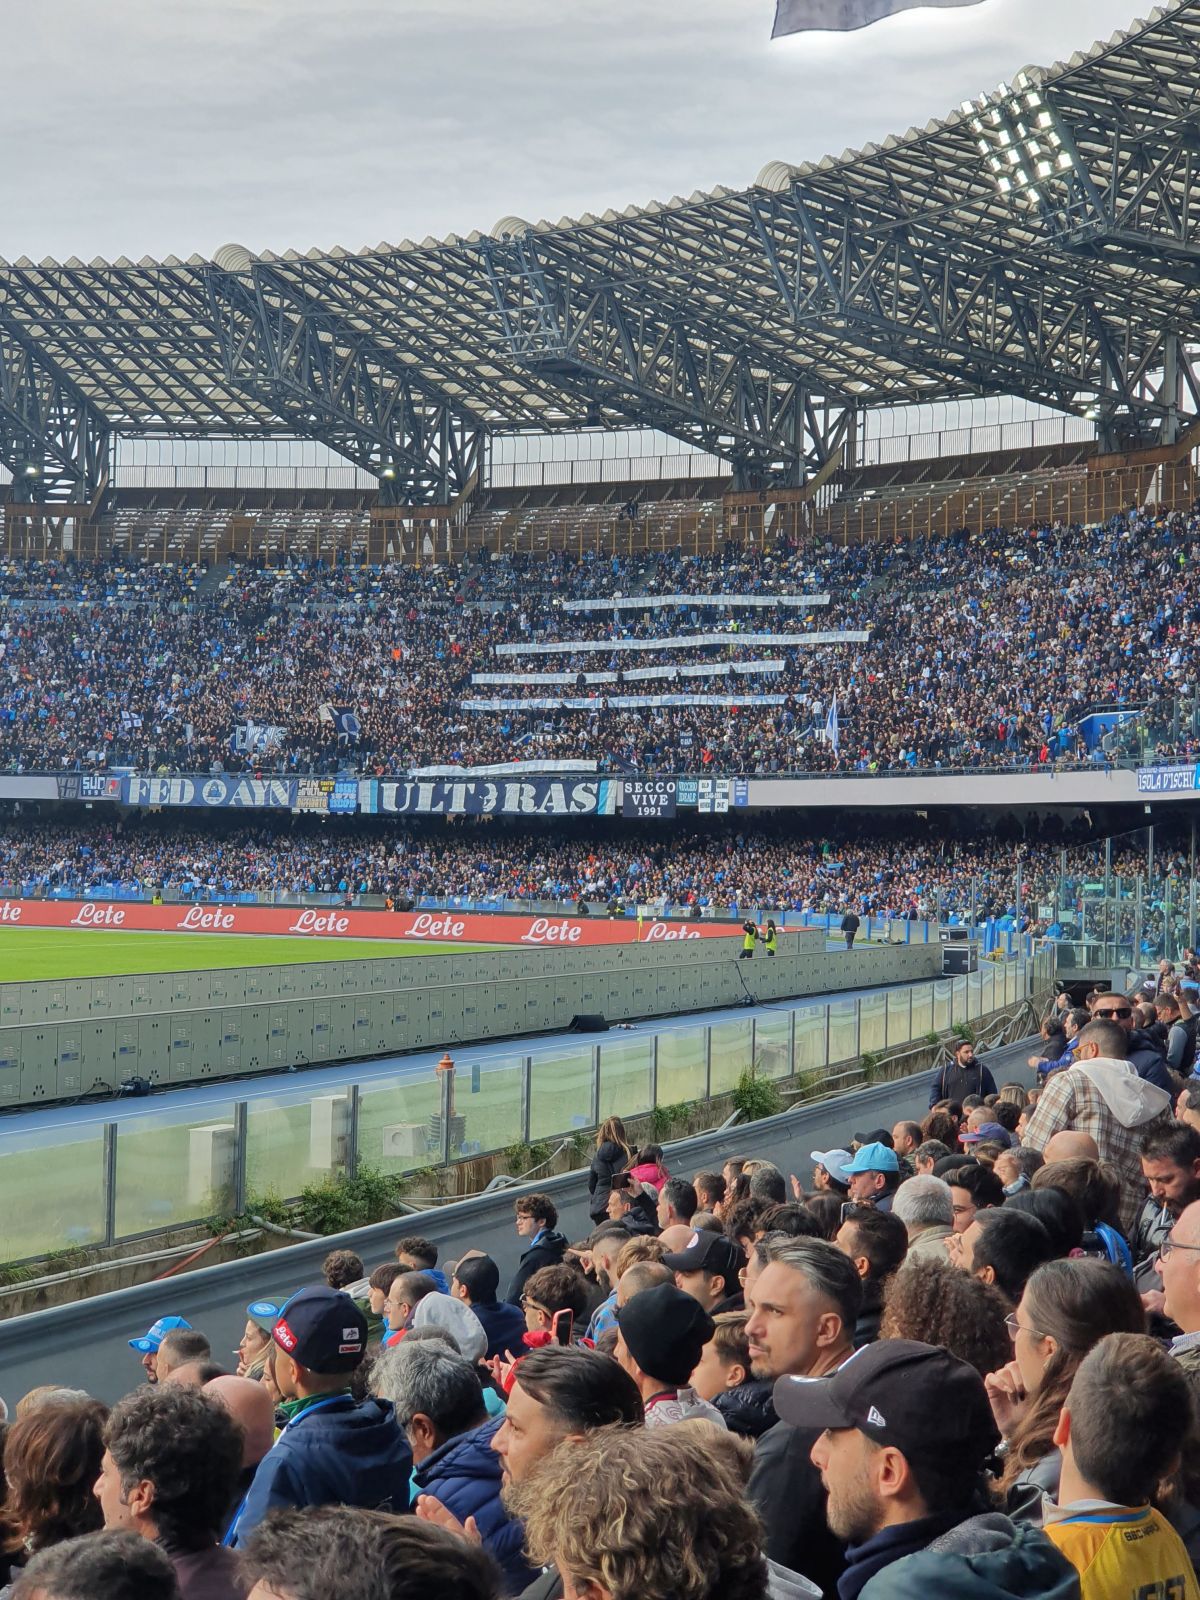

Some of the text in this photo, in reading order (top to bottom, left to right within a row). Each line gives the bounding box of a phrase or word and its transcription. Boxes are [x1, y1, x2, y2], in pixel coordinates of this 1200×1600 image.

[624, 781, 676, 793] SECCO
[1138, 773, 1161, 790] ISOLA
[631, 794, 669, 805] VIVE
[637, 807, 662, 816] 1991
[70, 903, 126, 926] Lete
[177, 906, 235, 930] Lete
[288, 909, 350, 933] Lete
[404, 913, 465, 937] Lete
[521, 918, 582, 943] Lete
[275, 1325, 294, 1348] Lete
